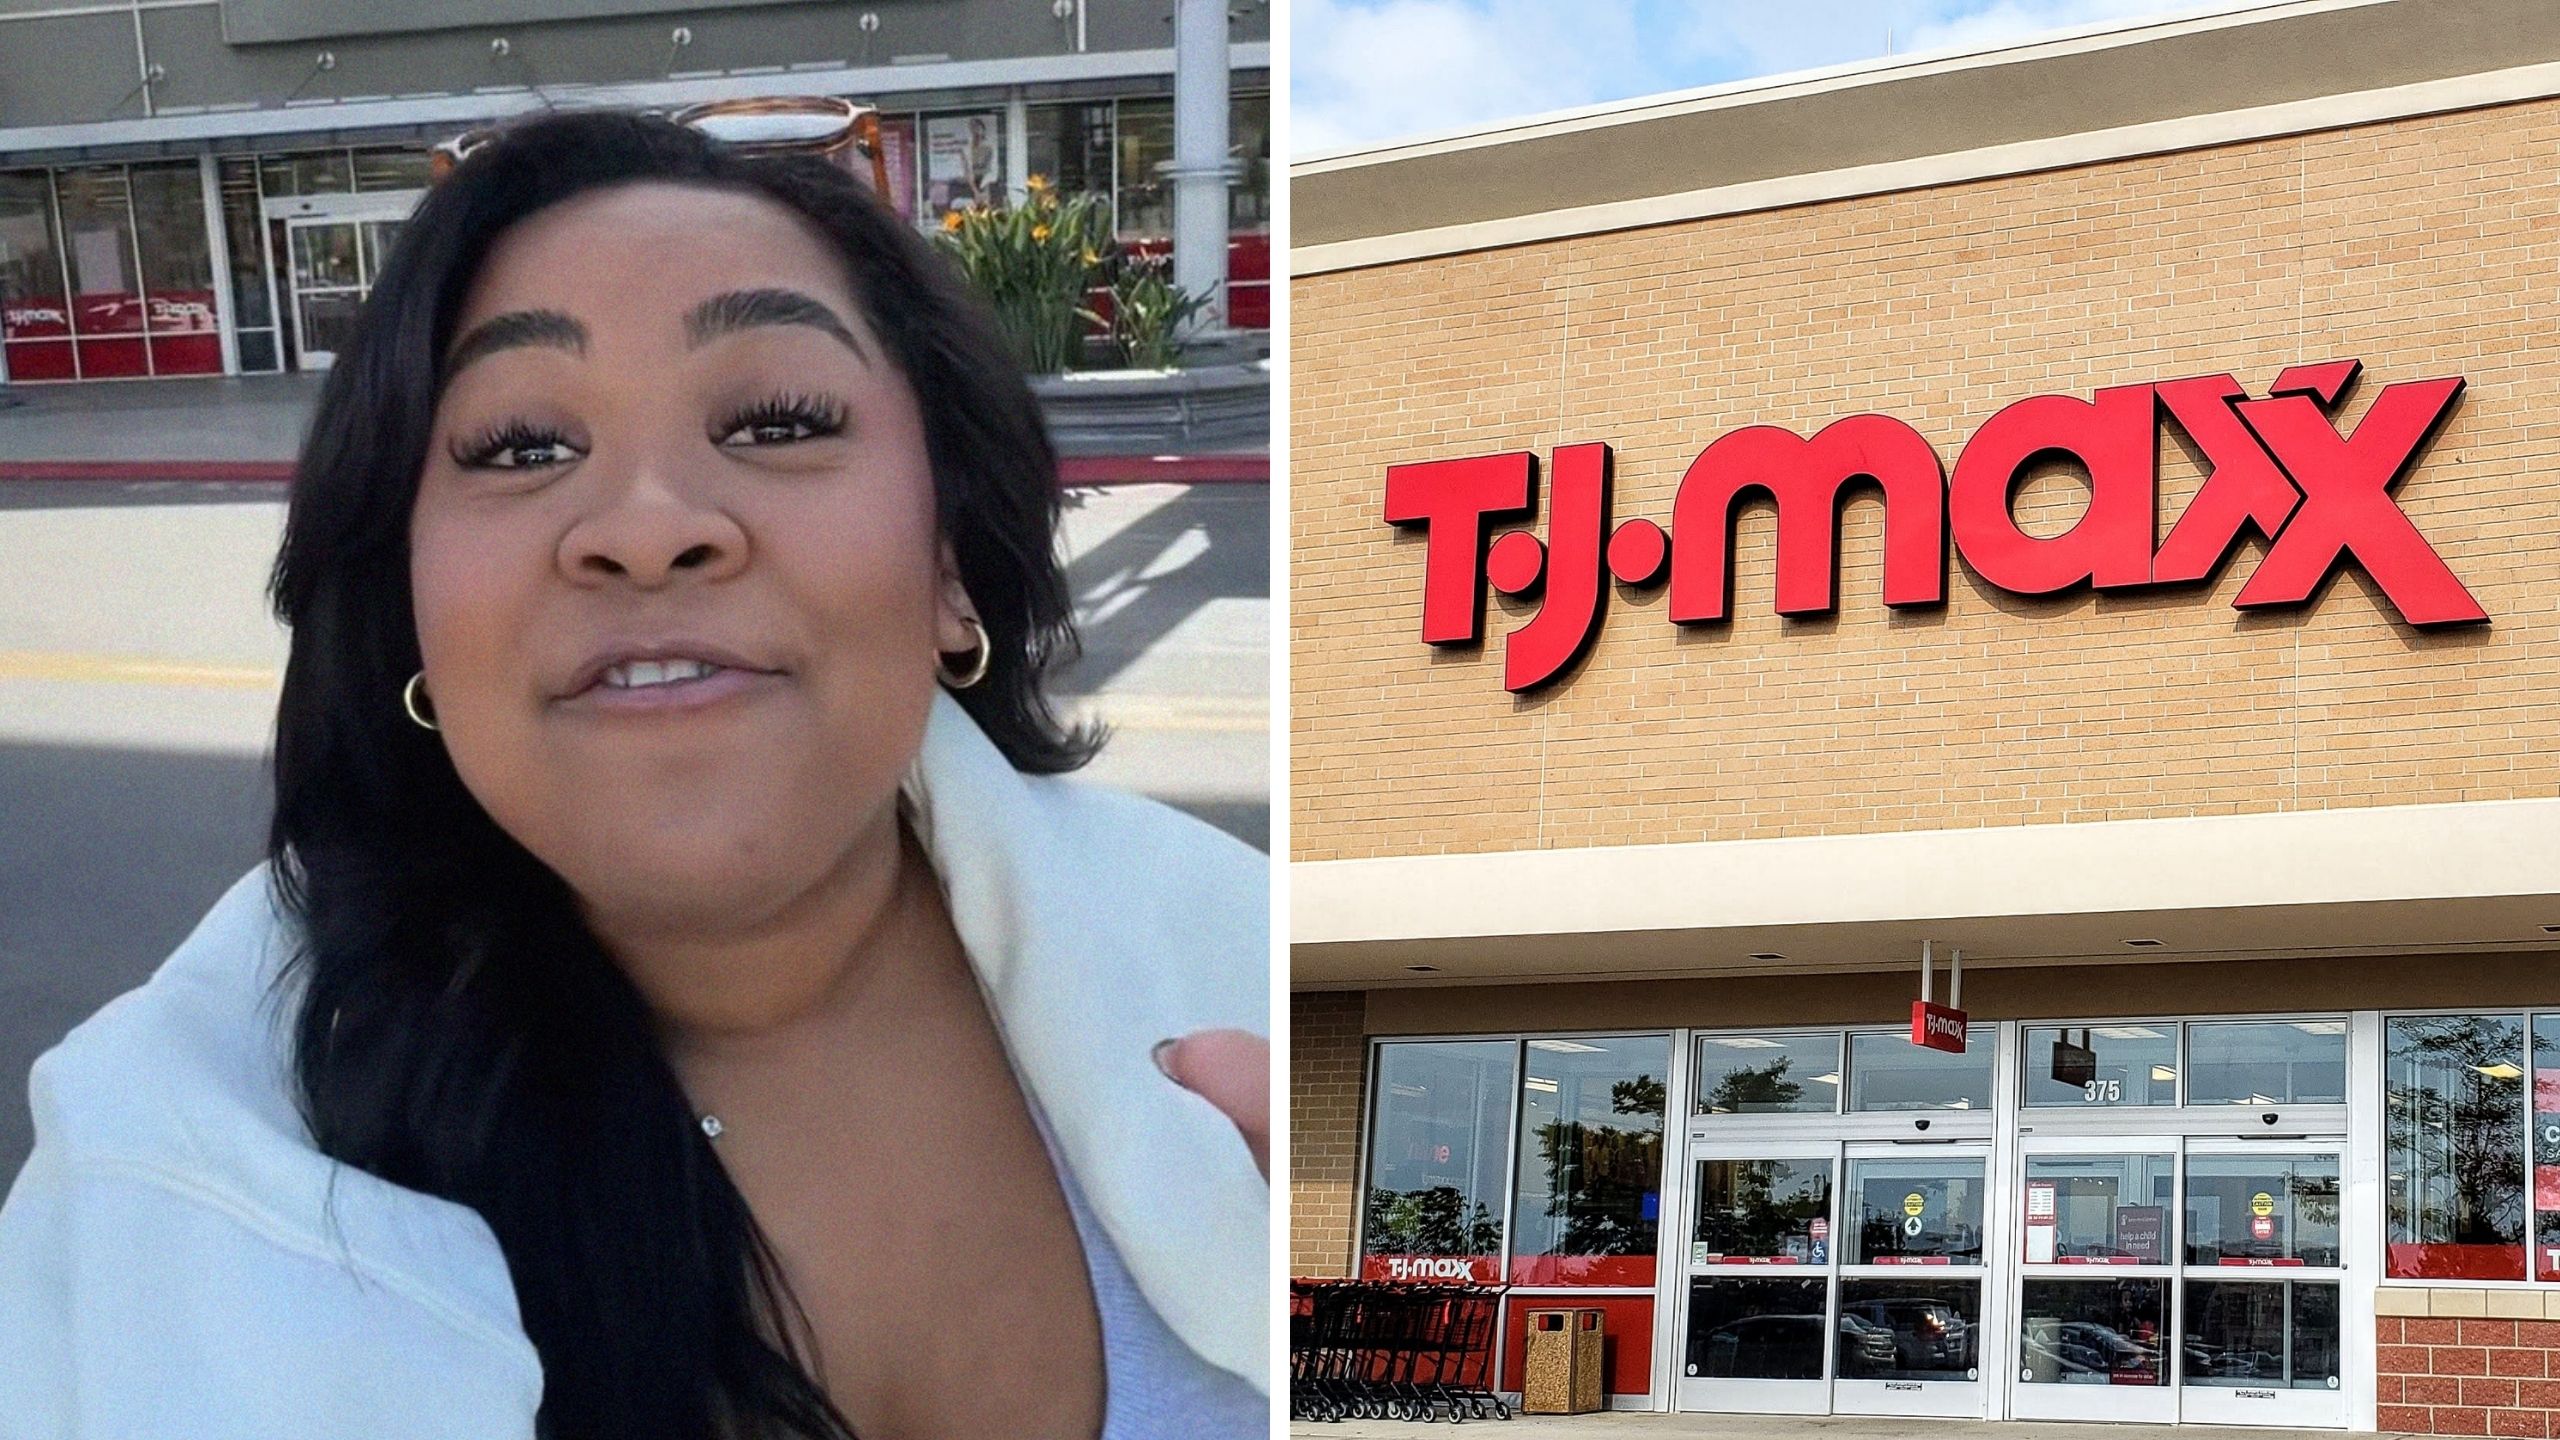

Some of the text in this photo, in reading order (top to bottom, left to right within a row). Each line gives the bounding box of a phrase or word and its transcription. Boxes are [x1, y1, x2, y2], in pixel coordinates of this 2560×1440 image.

[2084, 1080, 2120, 1102] 375
[2120, 1231, 2134, 1242] help
[2140, 1230, 2156, 1240] child
[2132, 1240, 2150, 1249] need
